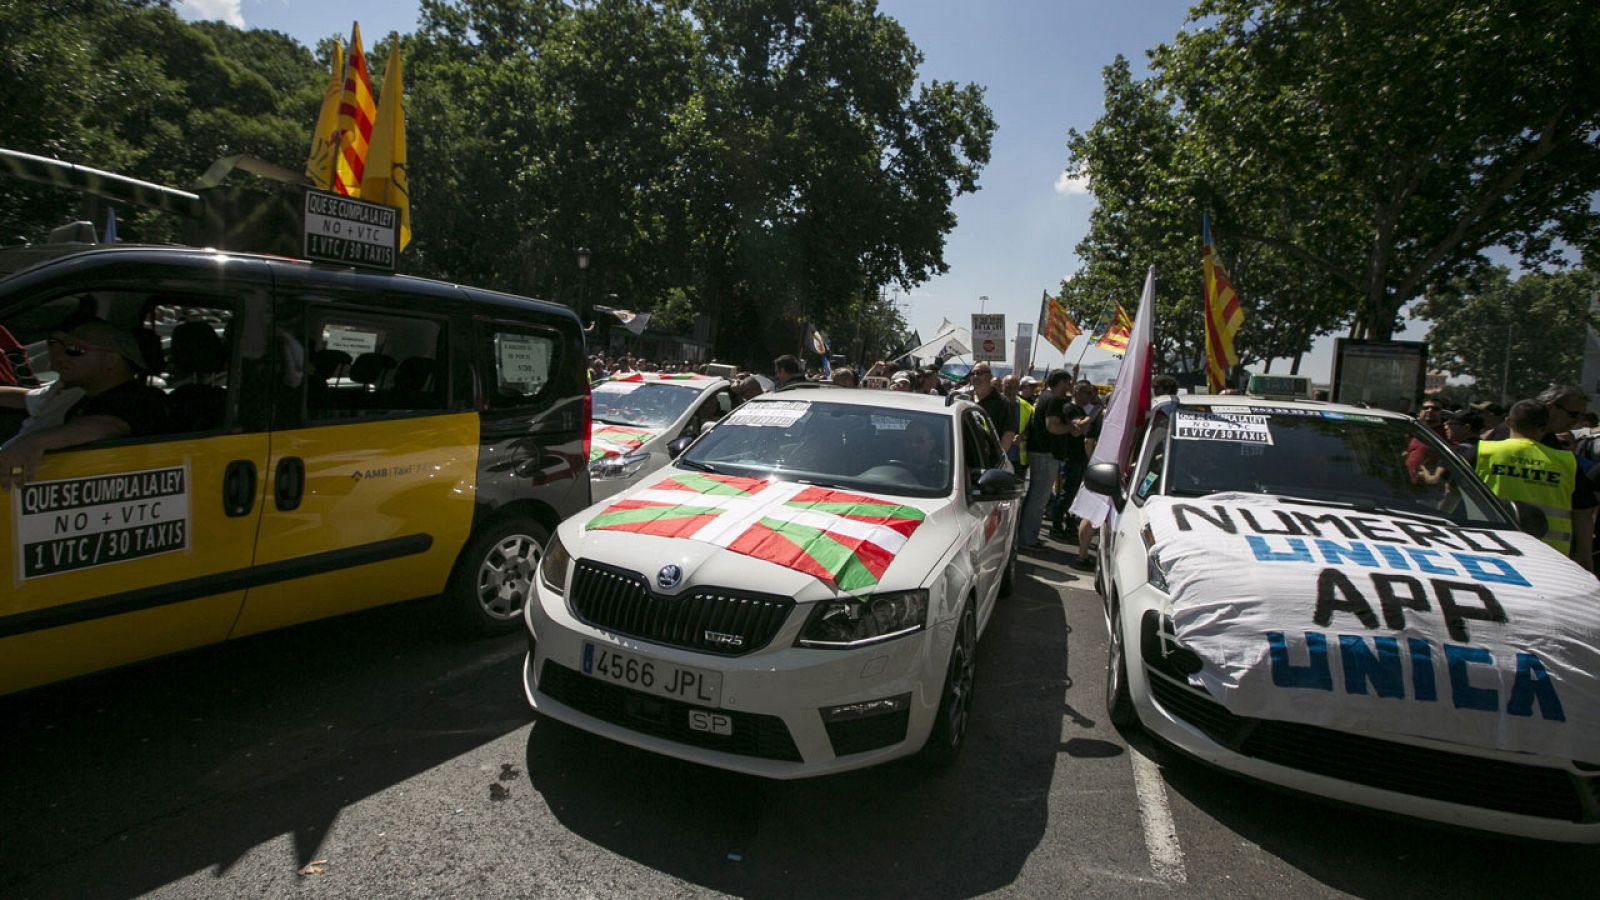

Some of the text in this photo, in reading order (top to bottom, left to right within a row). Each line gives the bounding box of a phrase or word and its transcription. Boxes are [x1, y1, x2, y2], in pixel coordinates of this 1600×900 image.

[309, 195, 392, 226] QUE SE CUMPLA LA LEY
[323, 220, 341, 233] NO
[358, 226, 380, 241] VTC
[320, 237, 340, 256] VTC
[349, 242, 361, 259] 30
[365, 245, 391, 264] TAXIS
[1191, 428, 1211, 437] VTC
[1221, 430, 1233, 439] 30
[1235, 431, 1266, 441] TAXIS
[24, 470, 182, 512] QUE SE CUMPLA LA LEY
[1492, 464, 1561, 483] ELITE
[54, 502, 162, 534] NO + VTC
[1171, 503, 1523, 557] NUMERO
[34, 544, 44, 569] 1
[52, 538, 88, 566] VTC
[108, 531, 129, 556] 30
[135, 522, 183, 551] TAXIS
[1244, 535, 1533, 587] UNICO
[1313, 568, 1509, 644] APP
[597, 651, 712, 702] 4566 JPL
[1266, 631, 1566, 722] UNICA
[693, 713, 727, 731] SP
